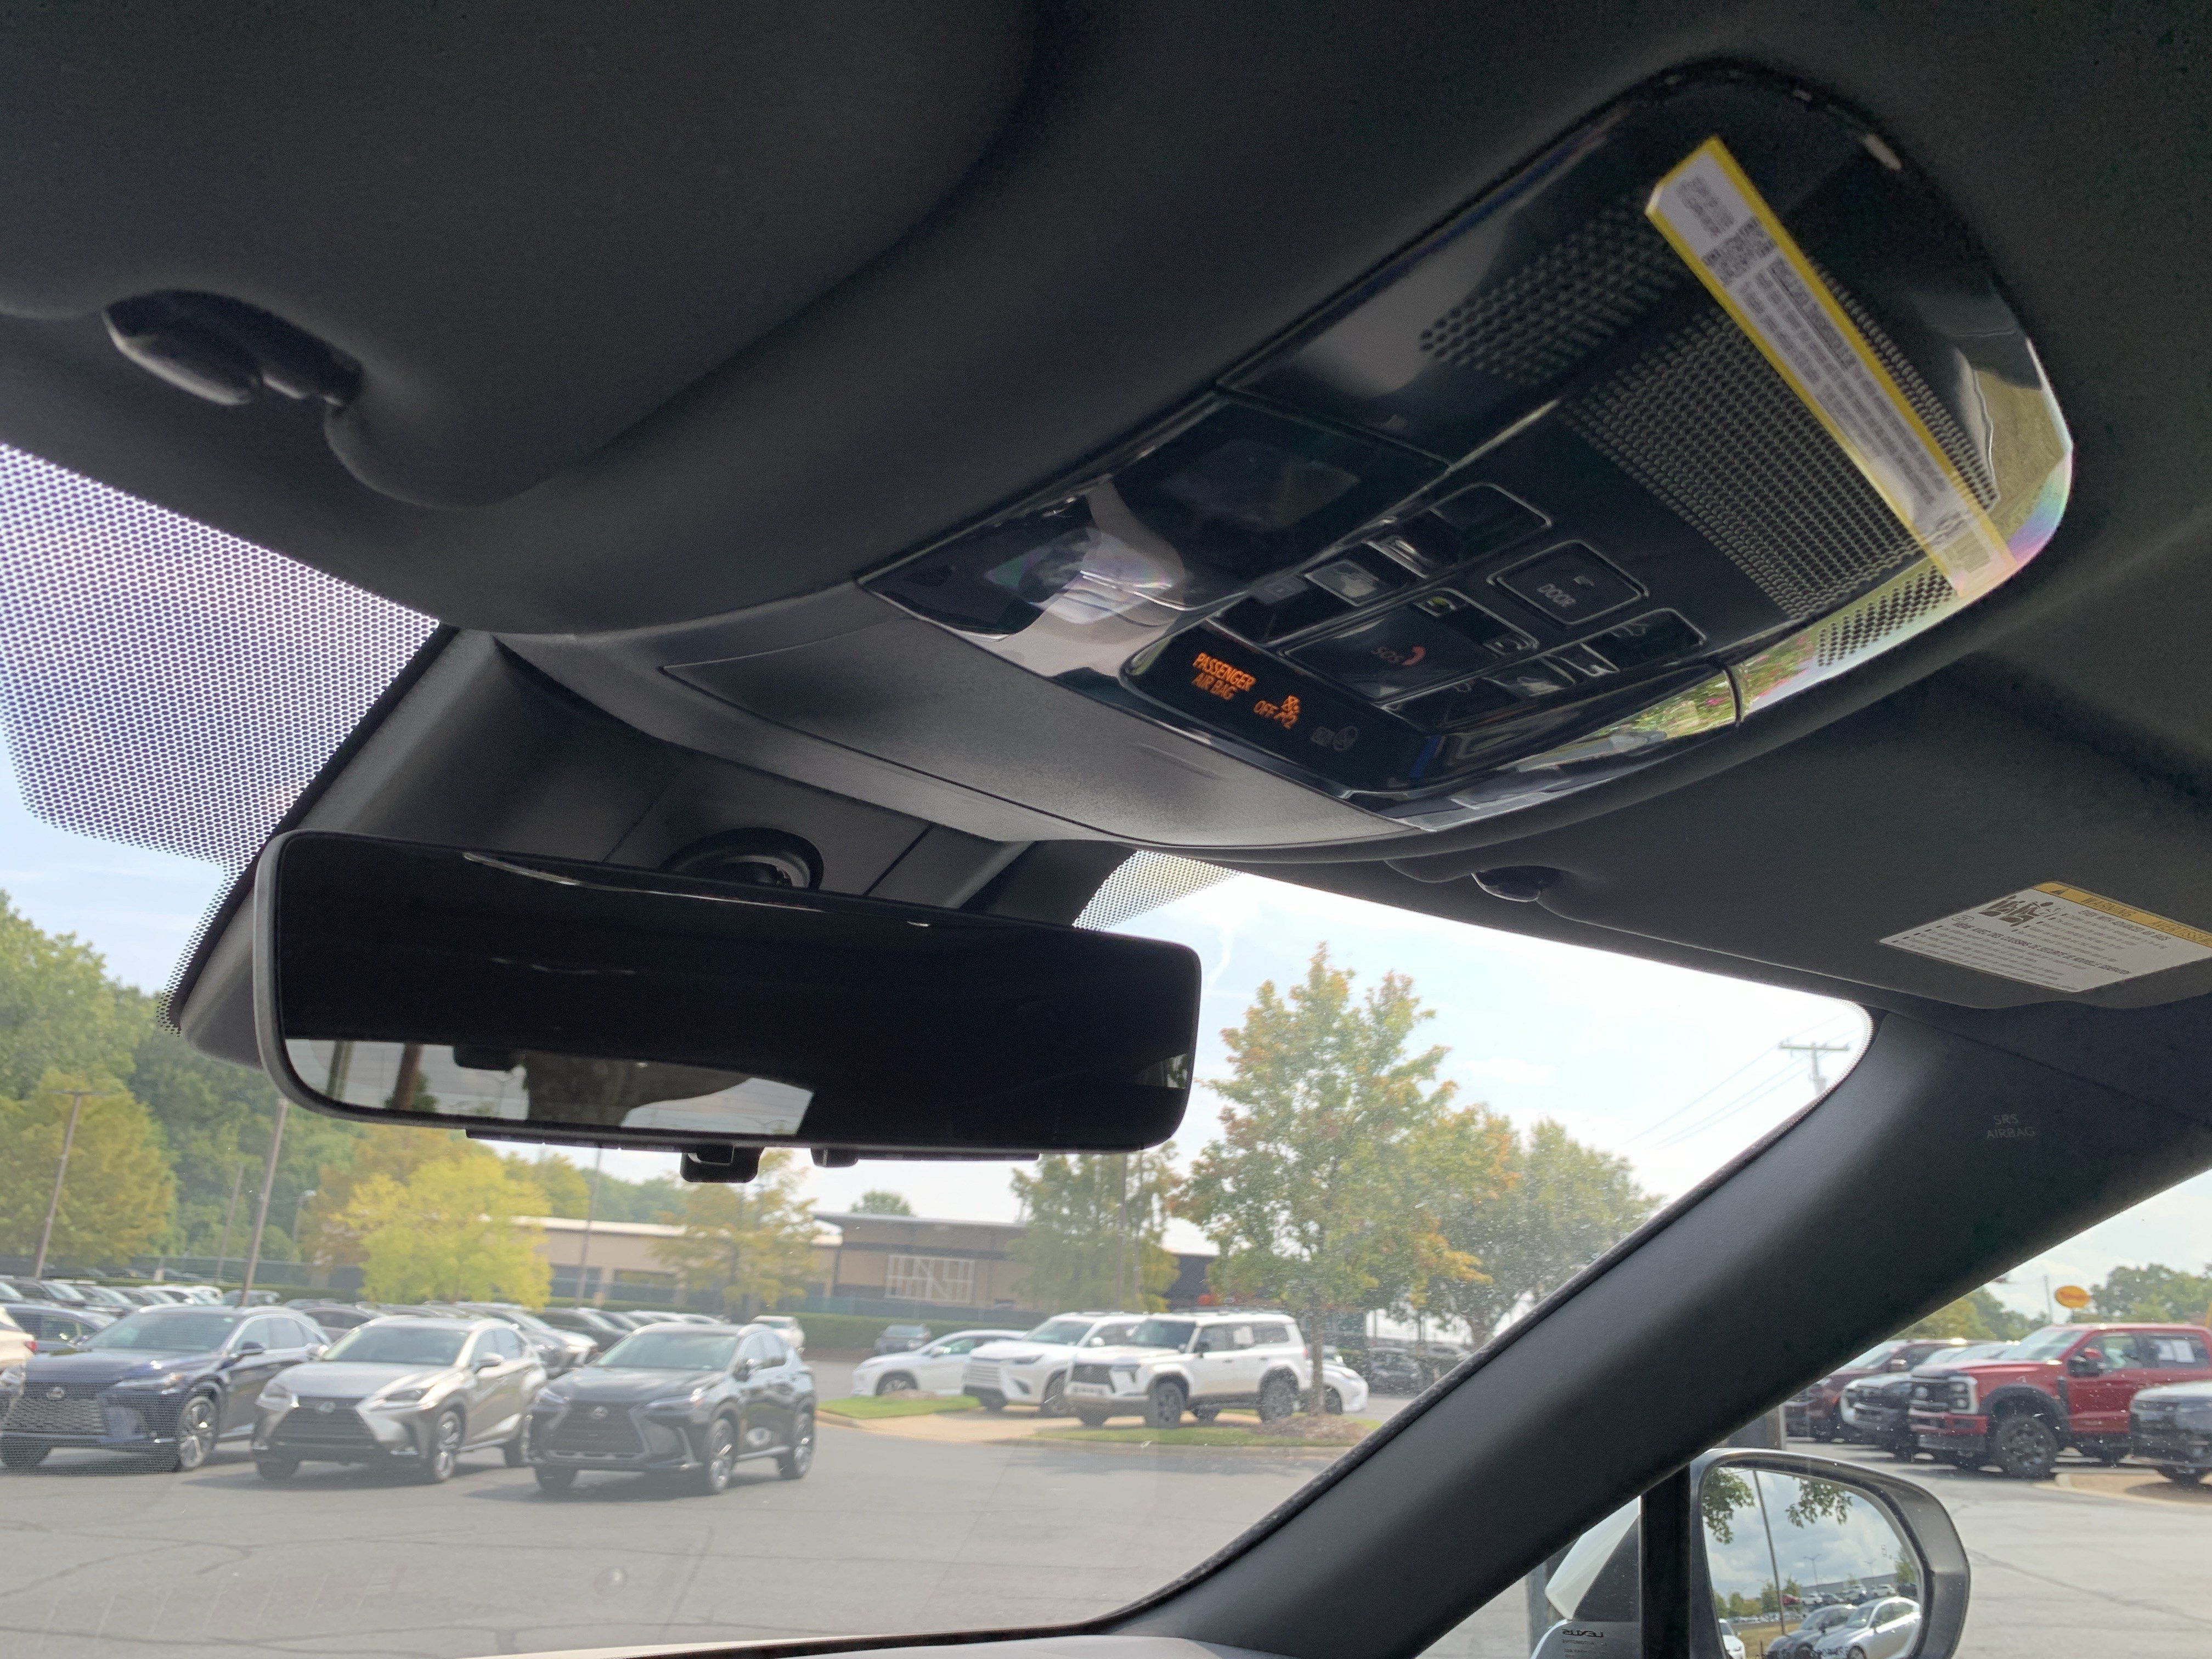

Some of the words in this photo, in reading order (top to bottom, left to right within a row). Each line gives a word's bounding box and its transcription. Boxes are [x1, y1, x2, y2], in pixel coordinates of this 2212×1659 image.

[1537, 583, 1576, 607] DOOR
[1371, 646, 1404, 663] SOS
[1192, 652, 1257, 692] PASSENGER
[1192, 673, 1216, 691] AIR
[1210, 680, 1238, 701] BAG
[1253, 700, 1279, 718] OFF
[2080, 897, 2137, 917] WARNING
[1993, 1113, 2019, 1125] SRS
[1987, 1126, 2036, 1139] AIRBAG
